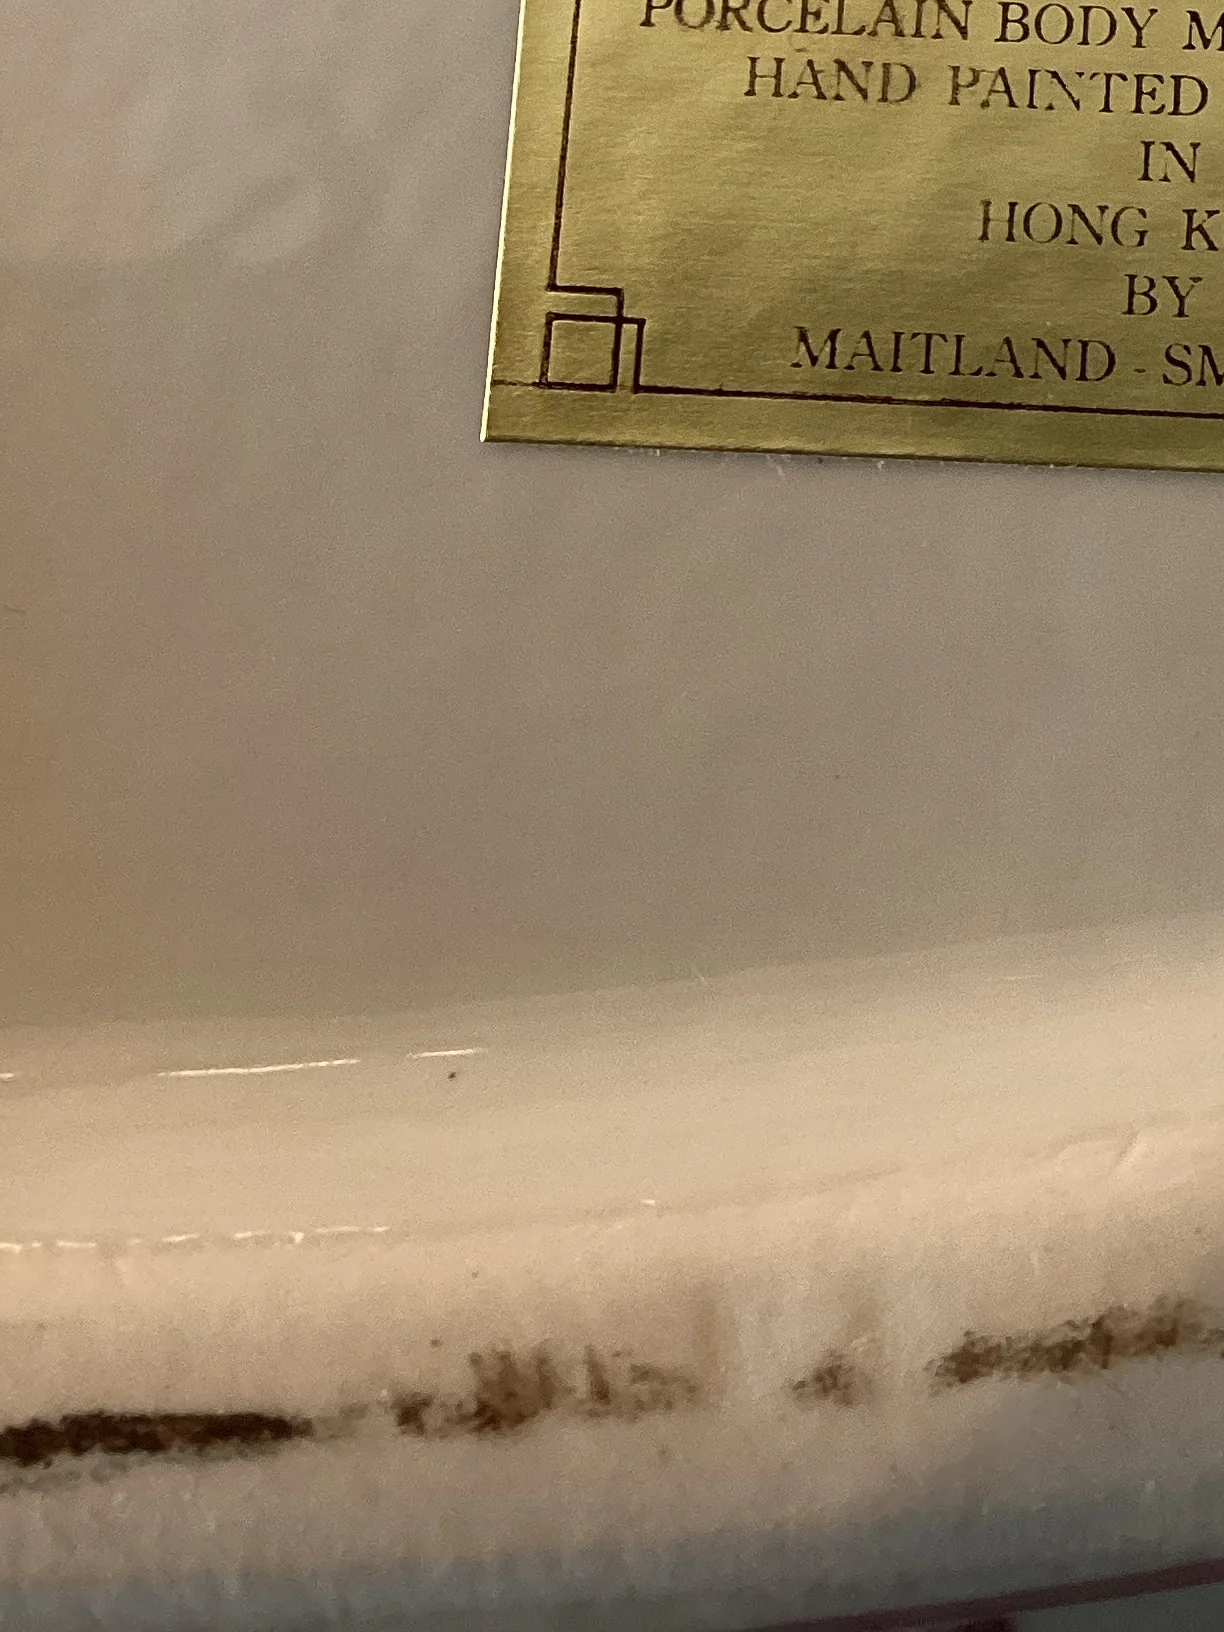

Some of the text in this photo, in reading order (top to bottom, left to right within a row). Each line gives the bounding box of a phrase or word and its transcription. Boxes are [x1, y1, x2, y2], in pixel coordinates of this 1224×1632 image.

[993, 0, 1160, 50] BODY
[743, 55, 918, 105] HAND
[947, 64, 1209, 117] PAINTED
[1136, 140, 1202, 183] IN
[977, 199, 1149, 249] HONG
[1121, 273, 1204, 319] BY
[789, 325, 1117, 384] MAITLAND
